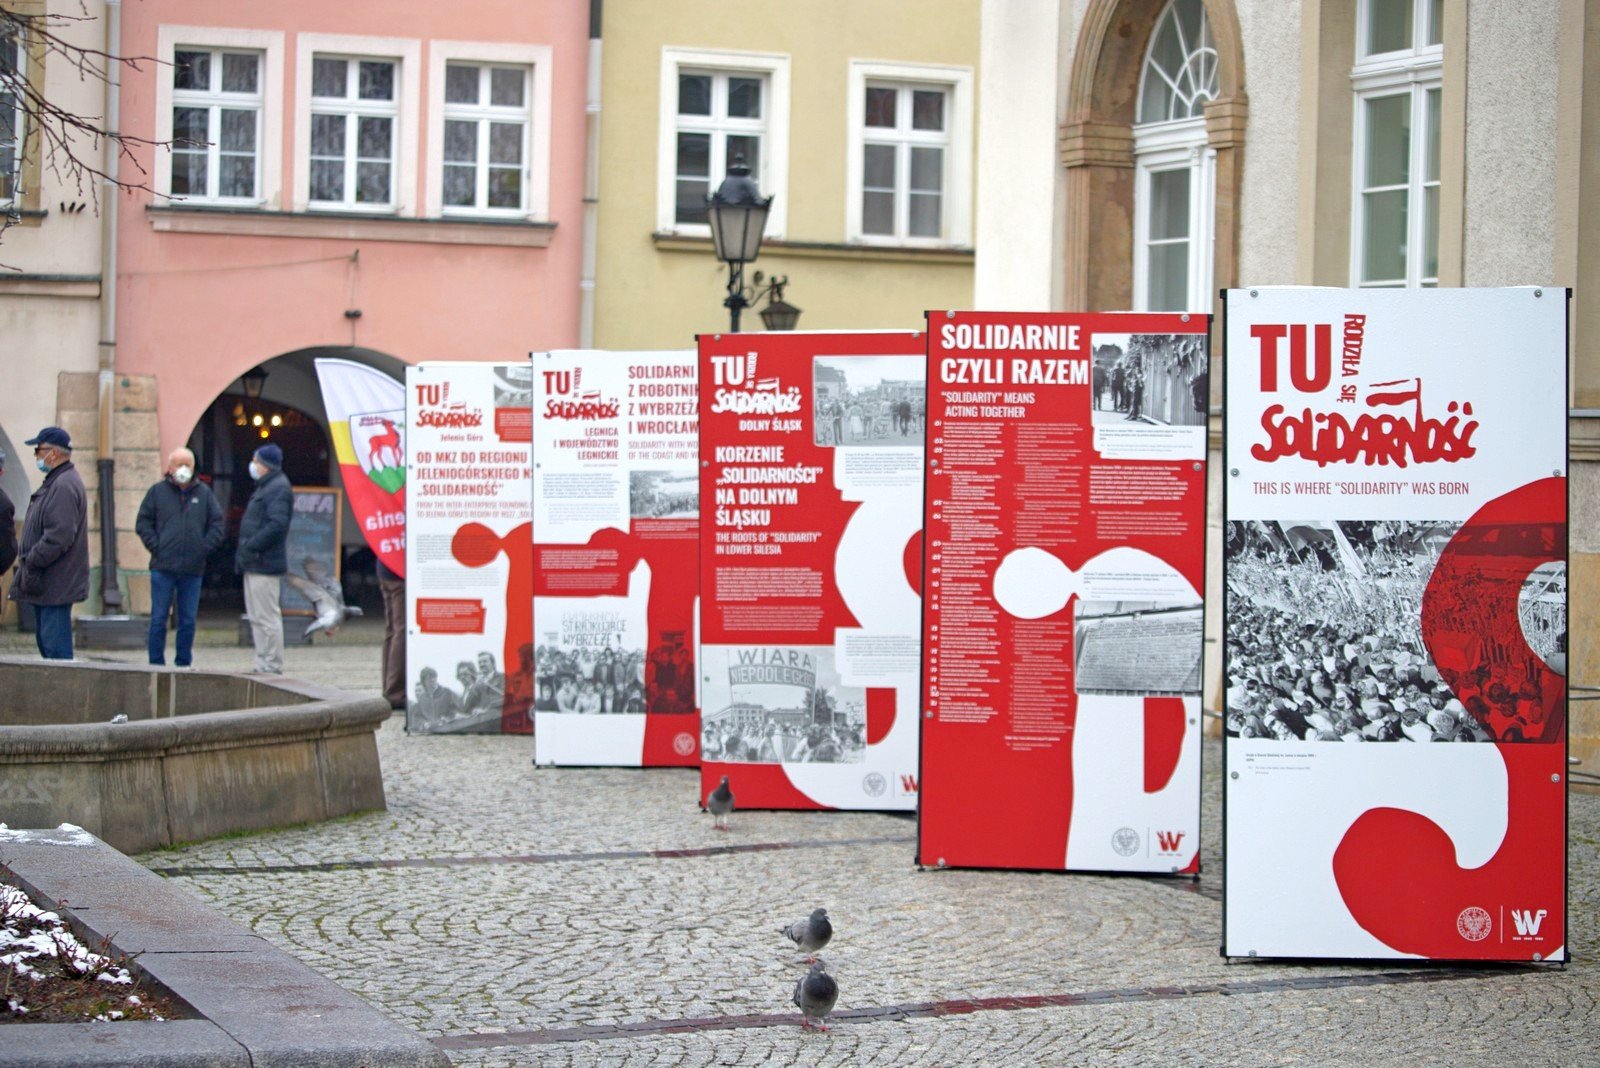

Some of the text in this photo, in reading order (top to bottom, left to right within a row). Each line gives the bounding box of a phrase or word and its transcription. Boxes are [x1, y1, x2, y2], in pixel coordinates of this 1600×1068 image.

[941, 324, 1080, 350] SOLIDARNIE
[1250, 324, 1331, 393] TU
[1337, 314, 1366, 404] RODZIŁA SIĘ
[628, 365, 694, 379] SOLIDARNI
[710, 356, 744, 386] TU
[941, 358, 1089, 385] CZYLI RAZEM
[543, 371, 570, 394] TU
[416, 385, 440, 406] TU
[628, 384, 634, 397] Z
[941, 391, 1035, 404] “SOLIDARITY” MEANS
[628, 403, 634, 416] Z
[945, 406, 1026, 418] ACTING TOGETHER
[585, 427, 618, 436] LEGNICA
[628, 421, 632, 434] I
[739, 416, 802, 434] DOLNY ŚLĄSK
[440, 434, 483, 442] Jelenia Góra
[560, 437, 619, 448] WOJEWÓDZTWO
[628, 441, 666, 449] SOLIDARITY
[668, 441, 684, 449] WITH
[417, 452, 527, 463] OD MKZ DO REGIONU
[578, 451, 619, 460] LEGNICKIE
[628, 451, 636, 459] OF
[638, 451, 649, 459] THE
[652, 451, 674, 459] COAST
[675, 451, 689, 459] AND
[716, 446, 784, 462] KORZENIE
[417, 465, 519, 480] JELENIOGÓRSKIEGO
[716, 462, 824, 486] „SOLIDARNOŚCI”
[1253, 482, 1469, 495] THIS IS WHERE “SOLIDARITY” WAS BORN
[716, 488, 798, 505] NA DOLNYM
[716, 504, 770, 530] ŚLĄSKU
[716, 532, 730, 542] THE
[732, 532, 757, 542] ROOTS
[758, 532, 768, 542] OF
[716, 544, 782, 554] IN LOWER SILESIA
[738, 648, 812, 670] WIARA
